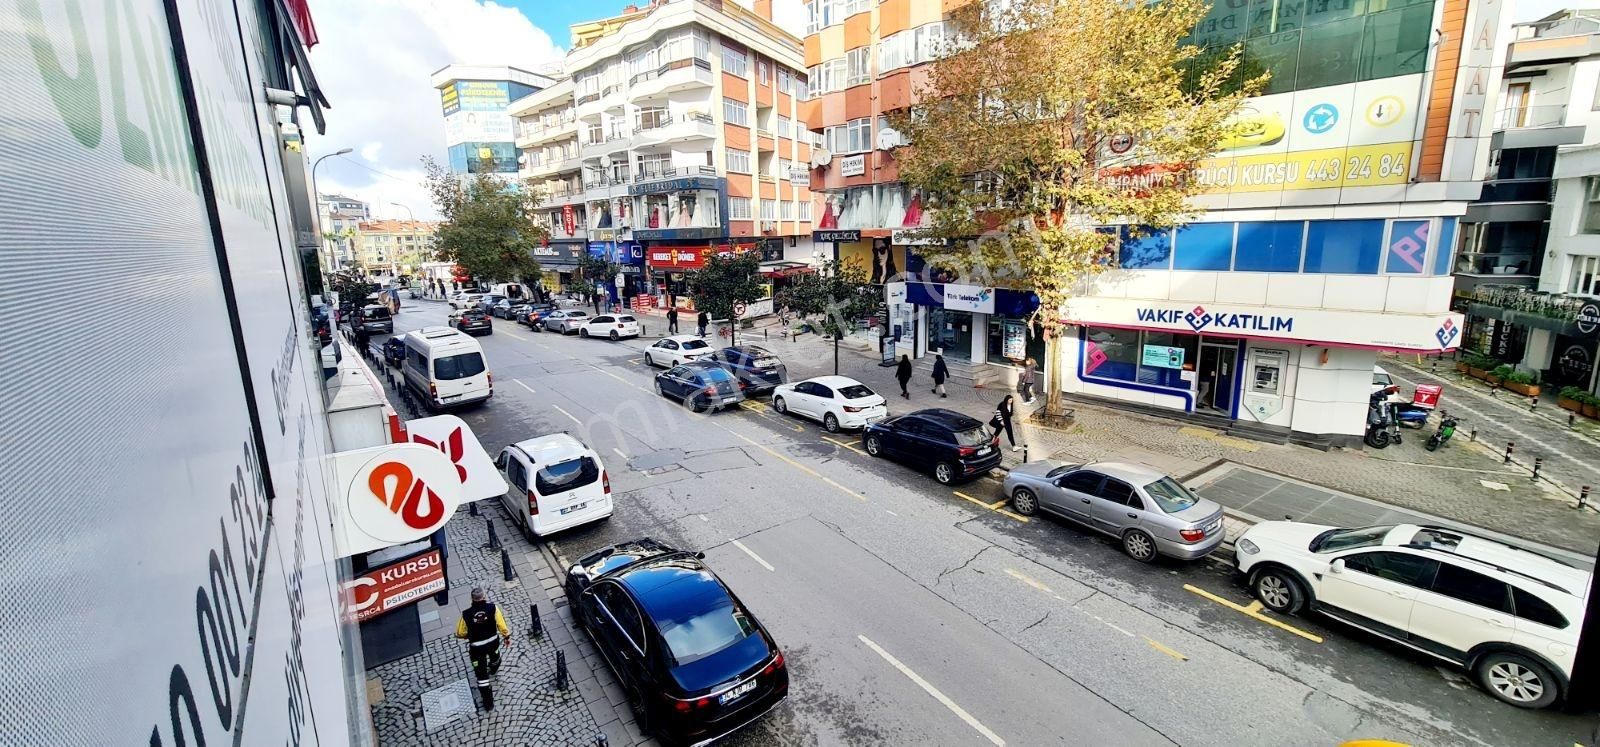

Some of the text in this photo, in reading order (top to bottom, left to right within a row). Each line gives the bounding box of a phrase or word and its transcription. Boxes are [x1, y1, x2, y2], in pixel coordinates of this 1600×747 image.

[1241, 161, 1300, 187] KURSU
[1305, 158, 1341, 182] 443
[1346, 154, 1371, 180] 24
[1378, 152, 1404, 178] 84
[1137, 307, 1293, 332] VAKIF KATILIM
[381, 553, 440, 584] KURSU
